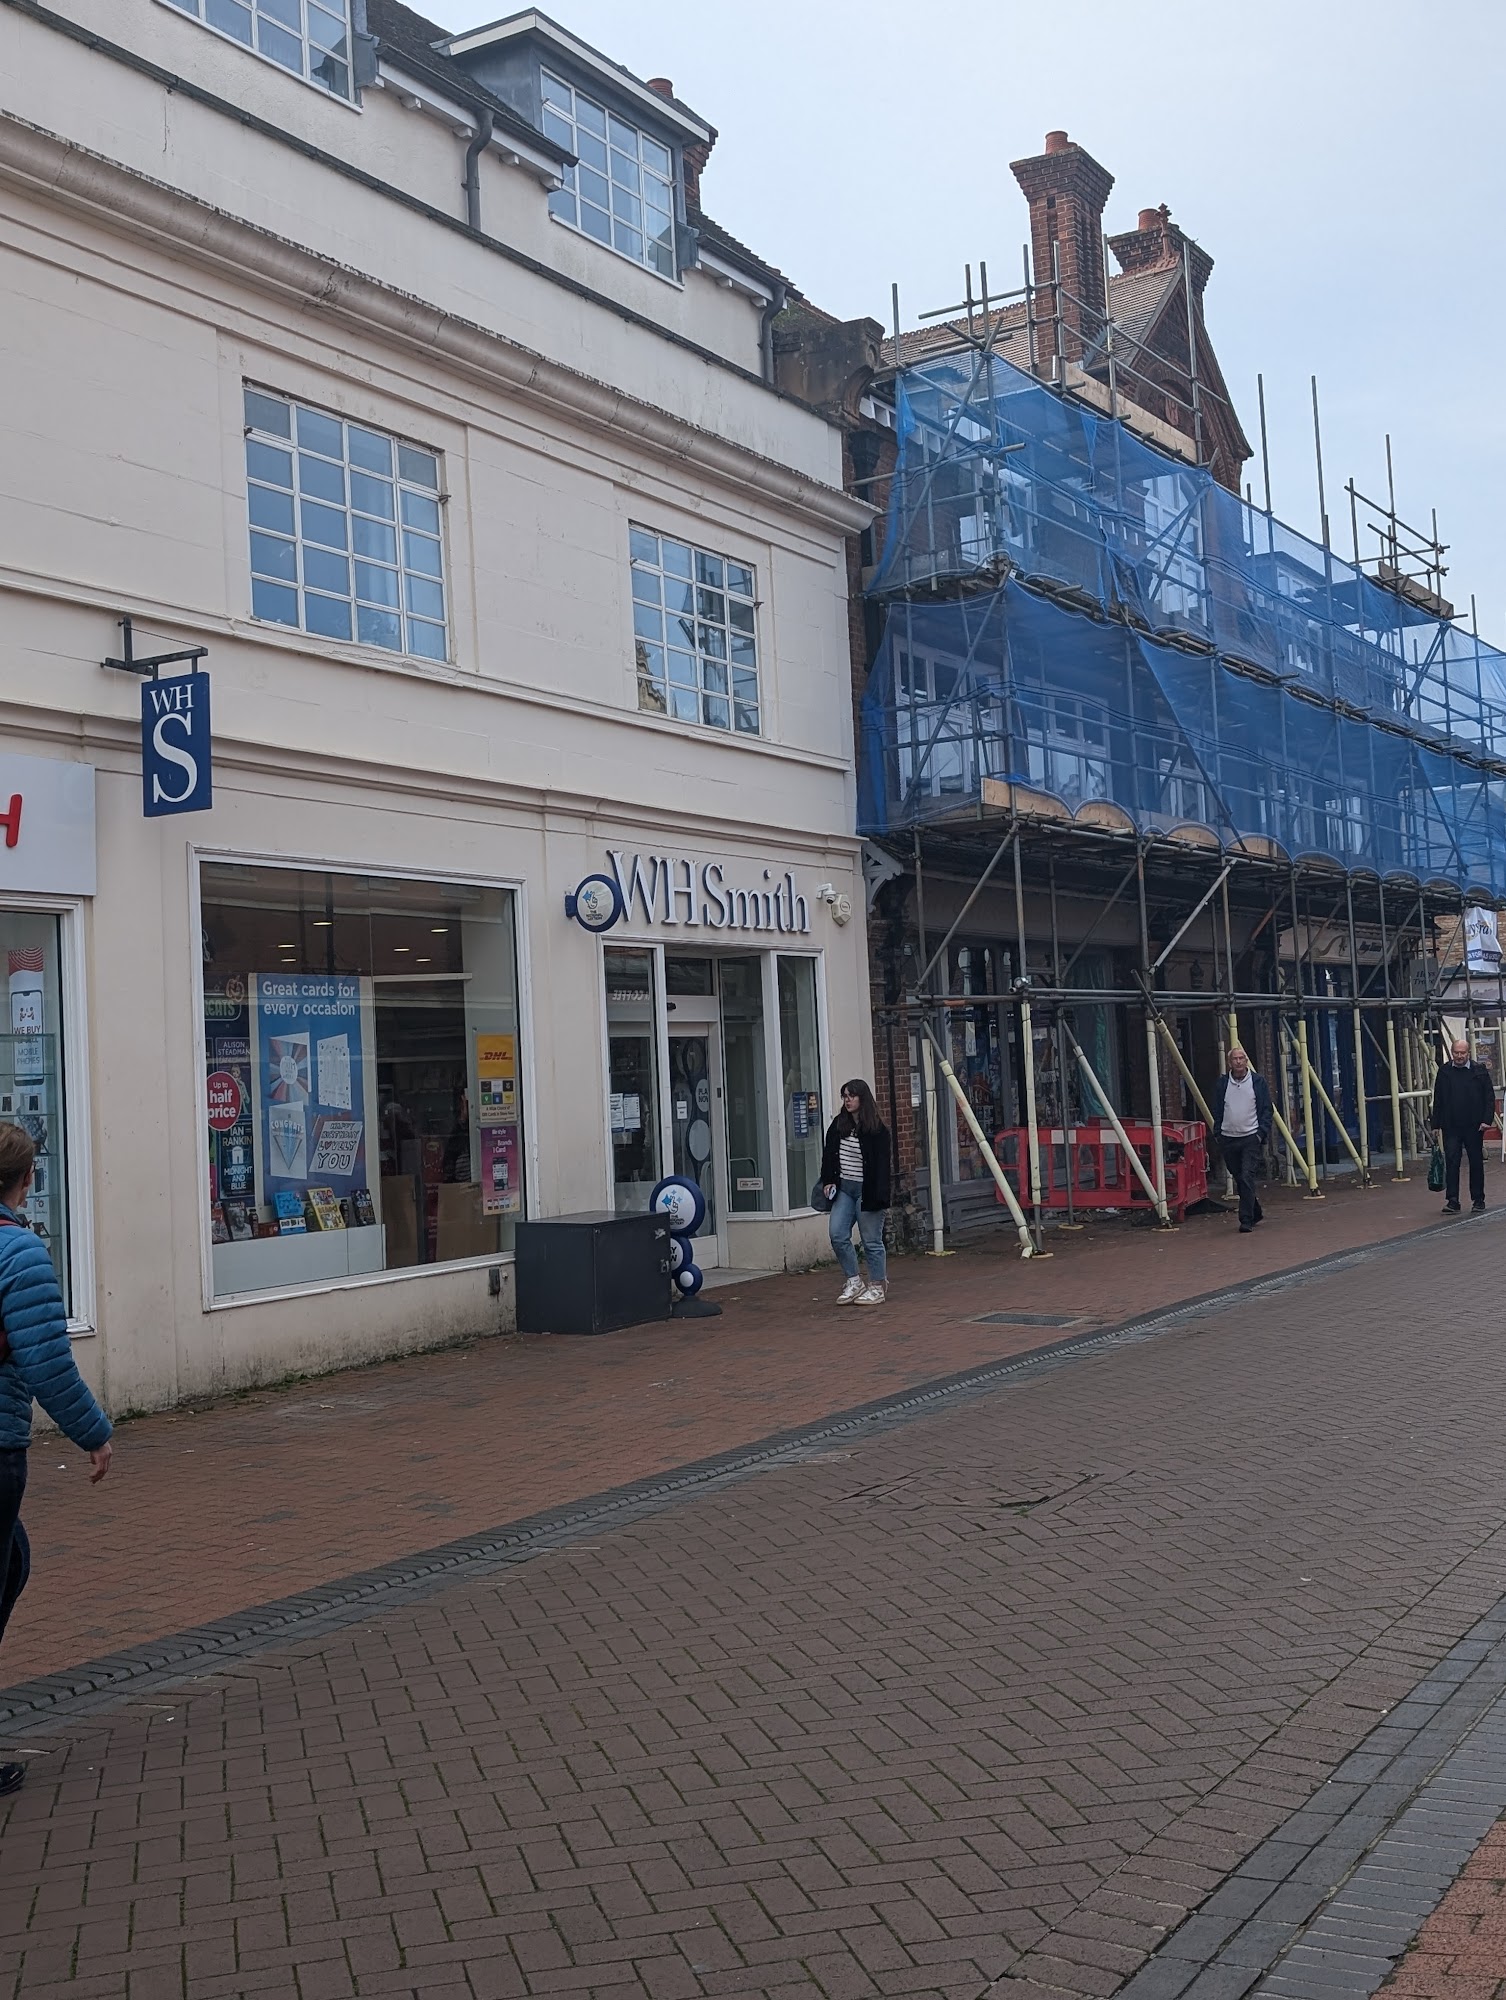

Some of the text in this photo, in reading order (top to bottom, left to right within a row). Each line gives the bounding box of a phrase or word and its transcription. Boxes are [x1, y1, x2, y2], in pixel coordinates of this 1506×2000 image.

[150, 684, 195, 715] WH
[153, 711, 198, 804] S
[606, 850, 812, 933] WHSmith
[262, 980, 356, 998] Great cards for
[263, 1001, 356, 1018] every occasion
[26, 1025, 41, 1034] BUY
[483, 1051, 507, 1061] DHL
[209, 1089, 233, 1104] half
[208, 1104, 236, 1118] price
[230, 1126, 245, 1136] IAN
[222, 1136, 253, 1147] RANKIN
[317, 1153, 351, 1170] YOU
[232, 1174, 246, 1183] AND
[230, 1182, 247, 1191] BLUE
